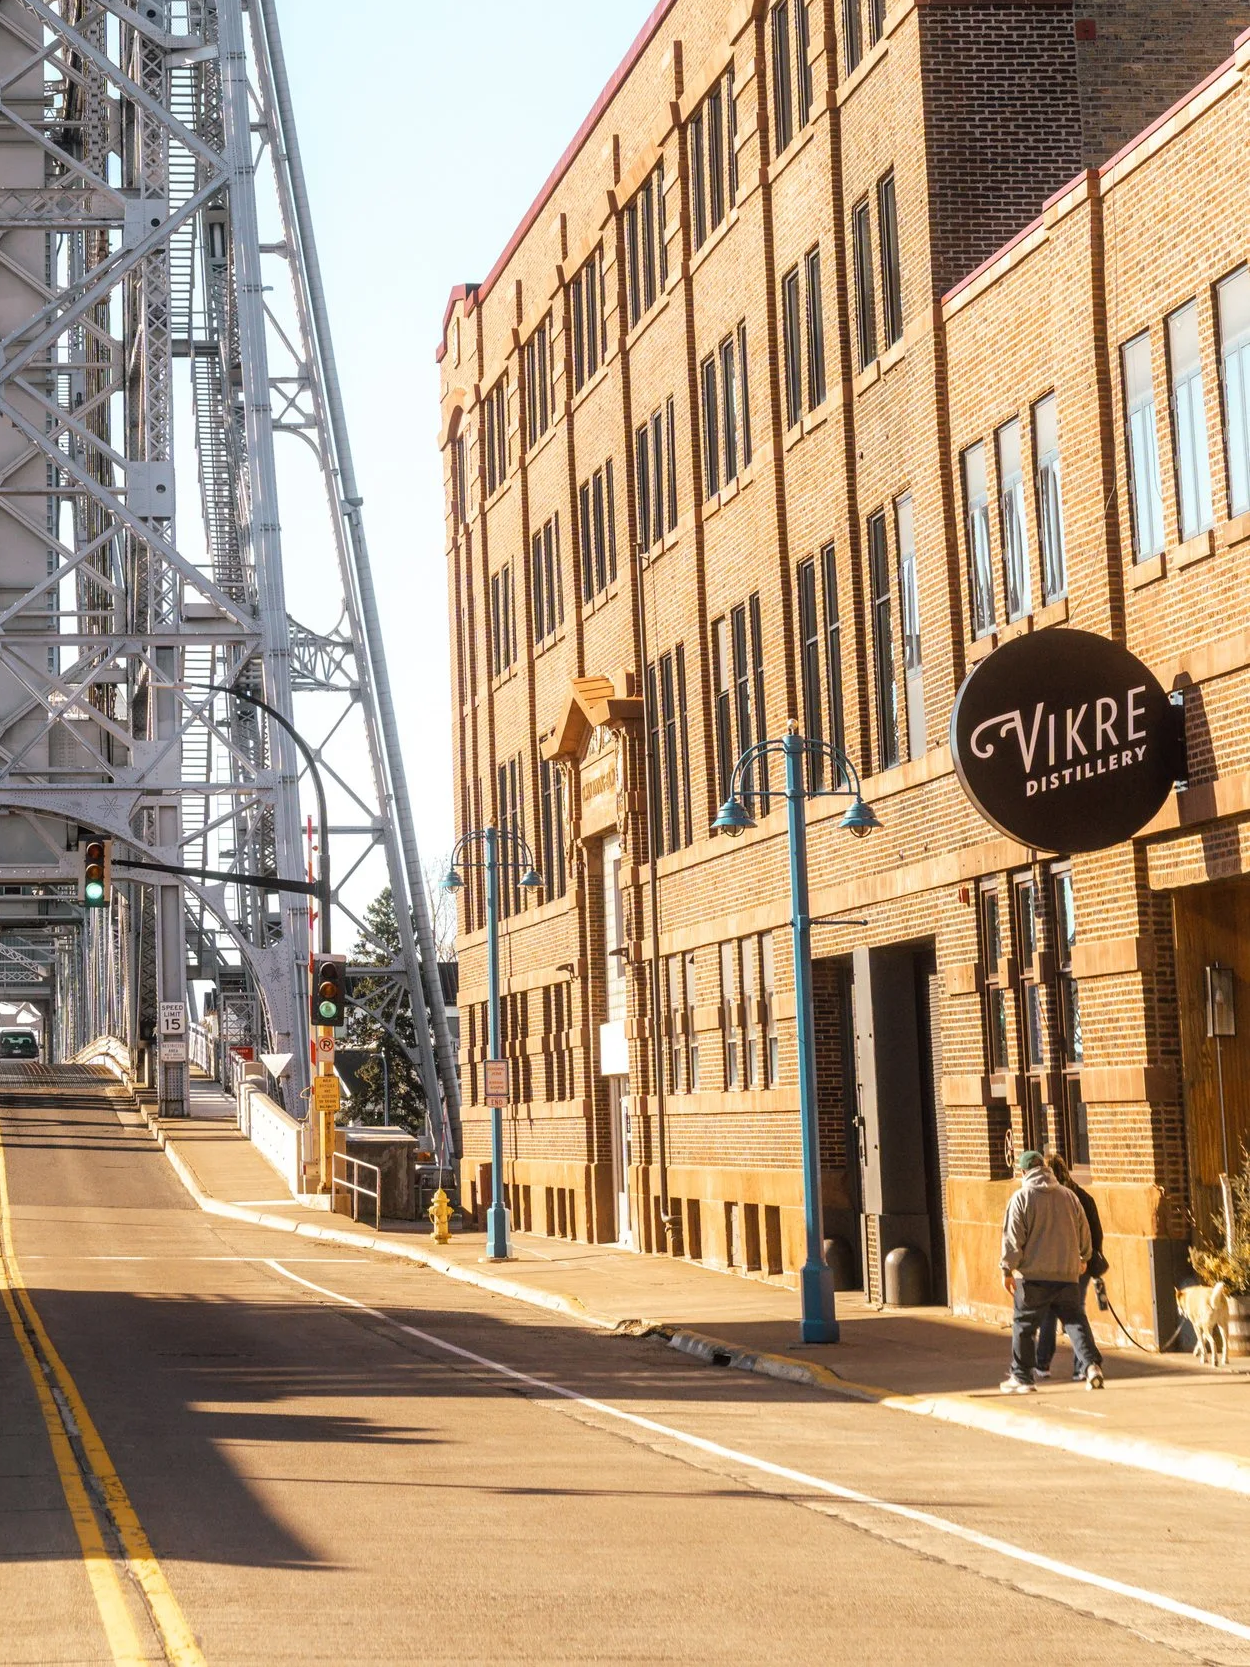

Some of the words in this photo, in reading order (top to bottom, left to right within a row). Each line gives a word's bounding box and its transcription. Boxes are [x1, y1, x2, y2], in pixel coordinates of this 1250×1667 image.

[970, 684, 1147, 773] VIKRE
[1025, 744, 1147, 798] DISTILLERY
[165, 1018, 181, 1030] 15
